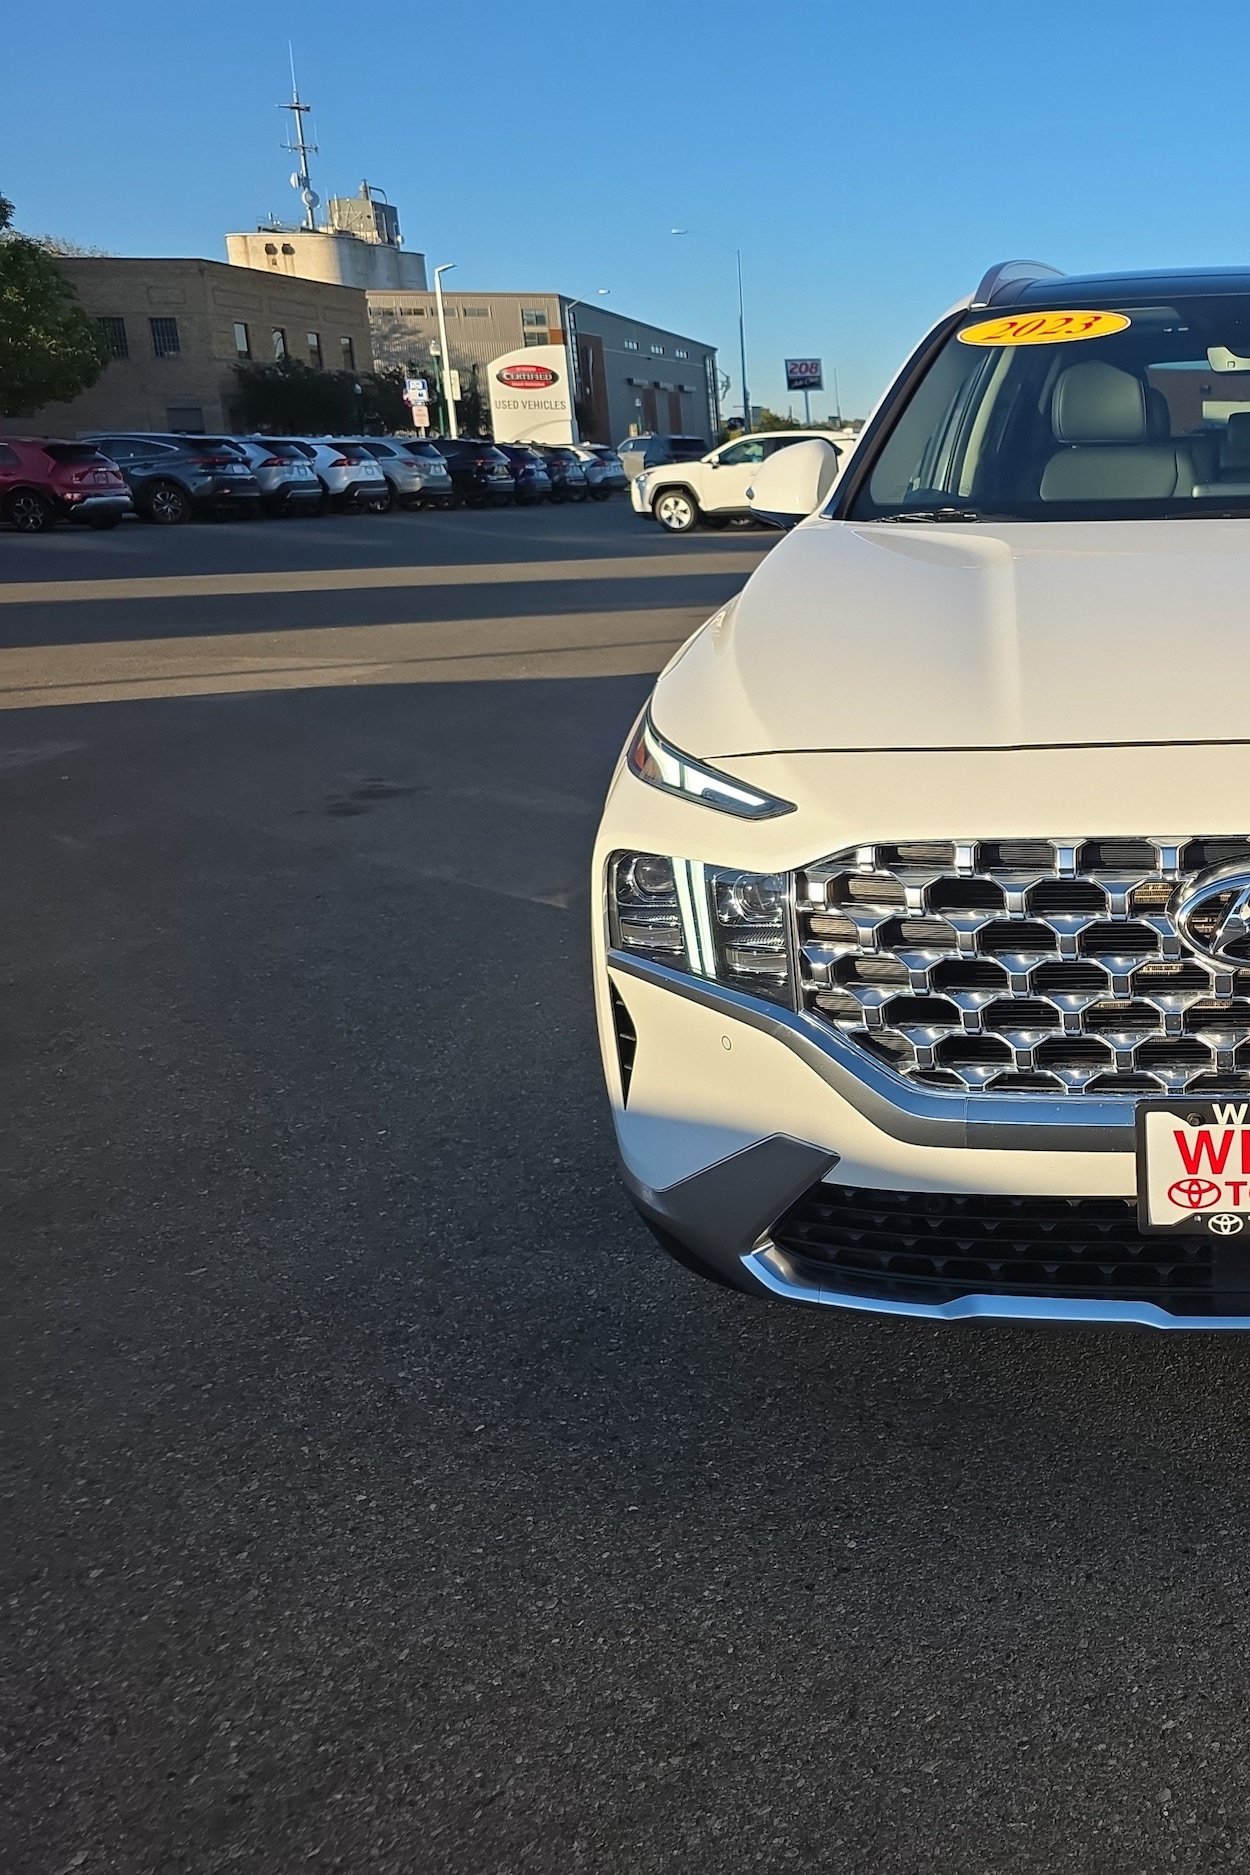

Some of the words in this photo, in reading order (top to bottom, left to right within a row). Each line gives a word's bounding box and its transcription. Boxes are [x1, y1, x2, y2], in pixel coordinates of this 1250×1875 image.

[981, 316, 1102, 341] 2023
[495, 400, 519, 410] USED
[521, 400, 567, 411] VEHICLES
